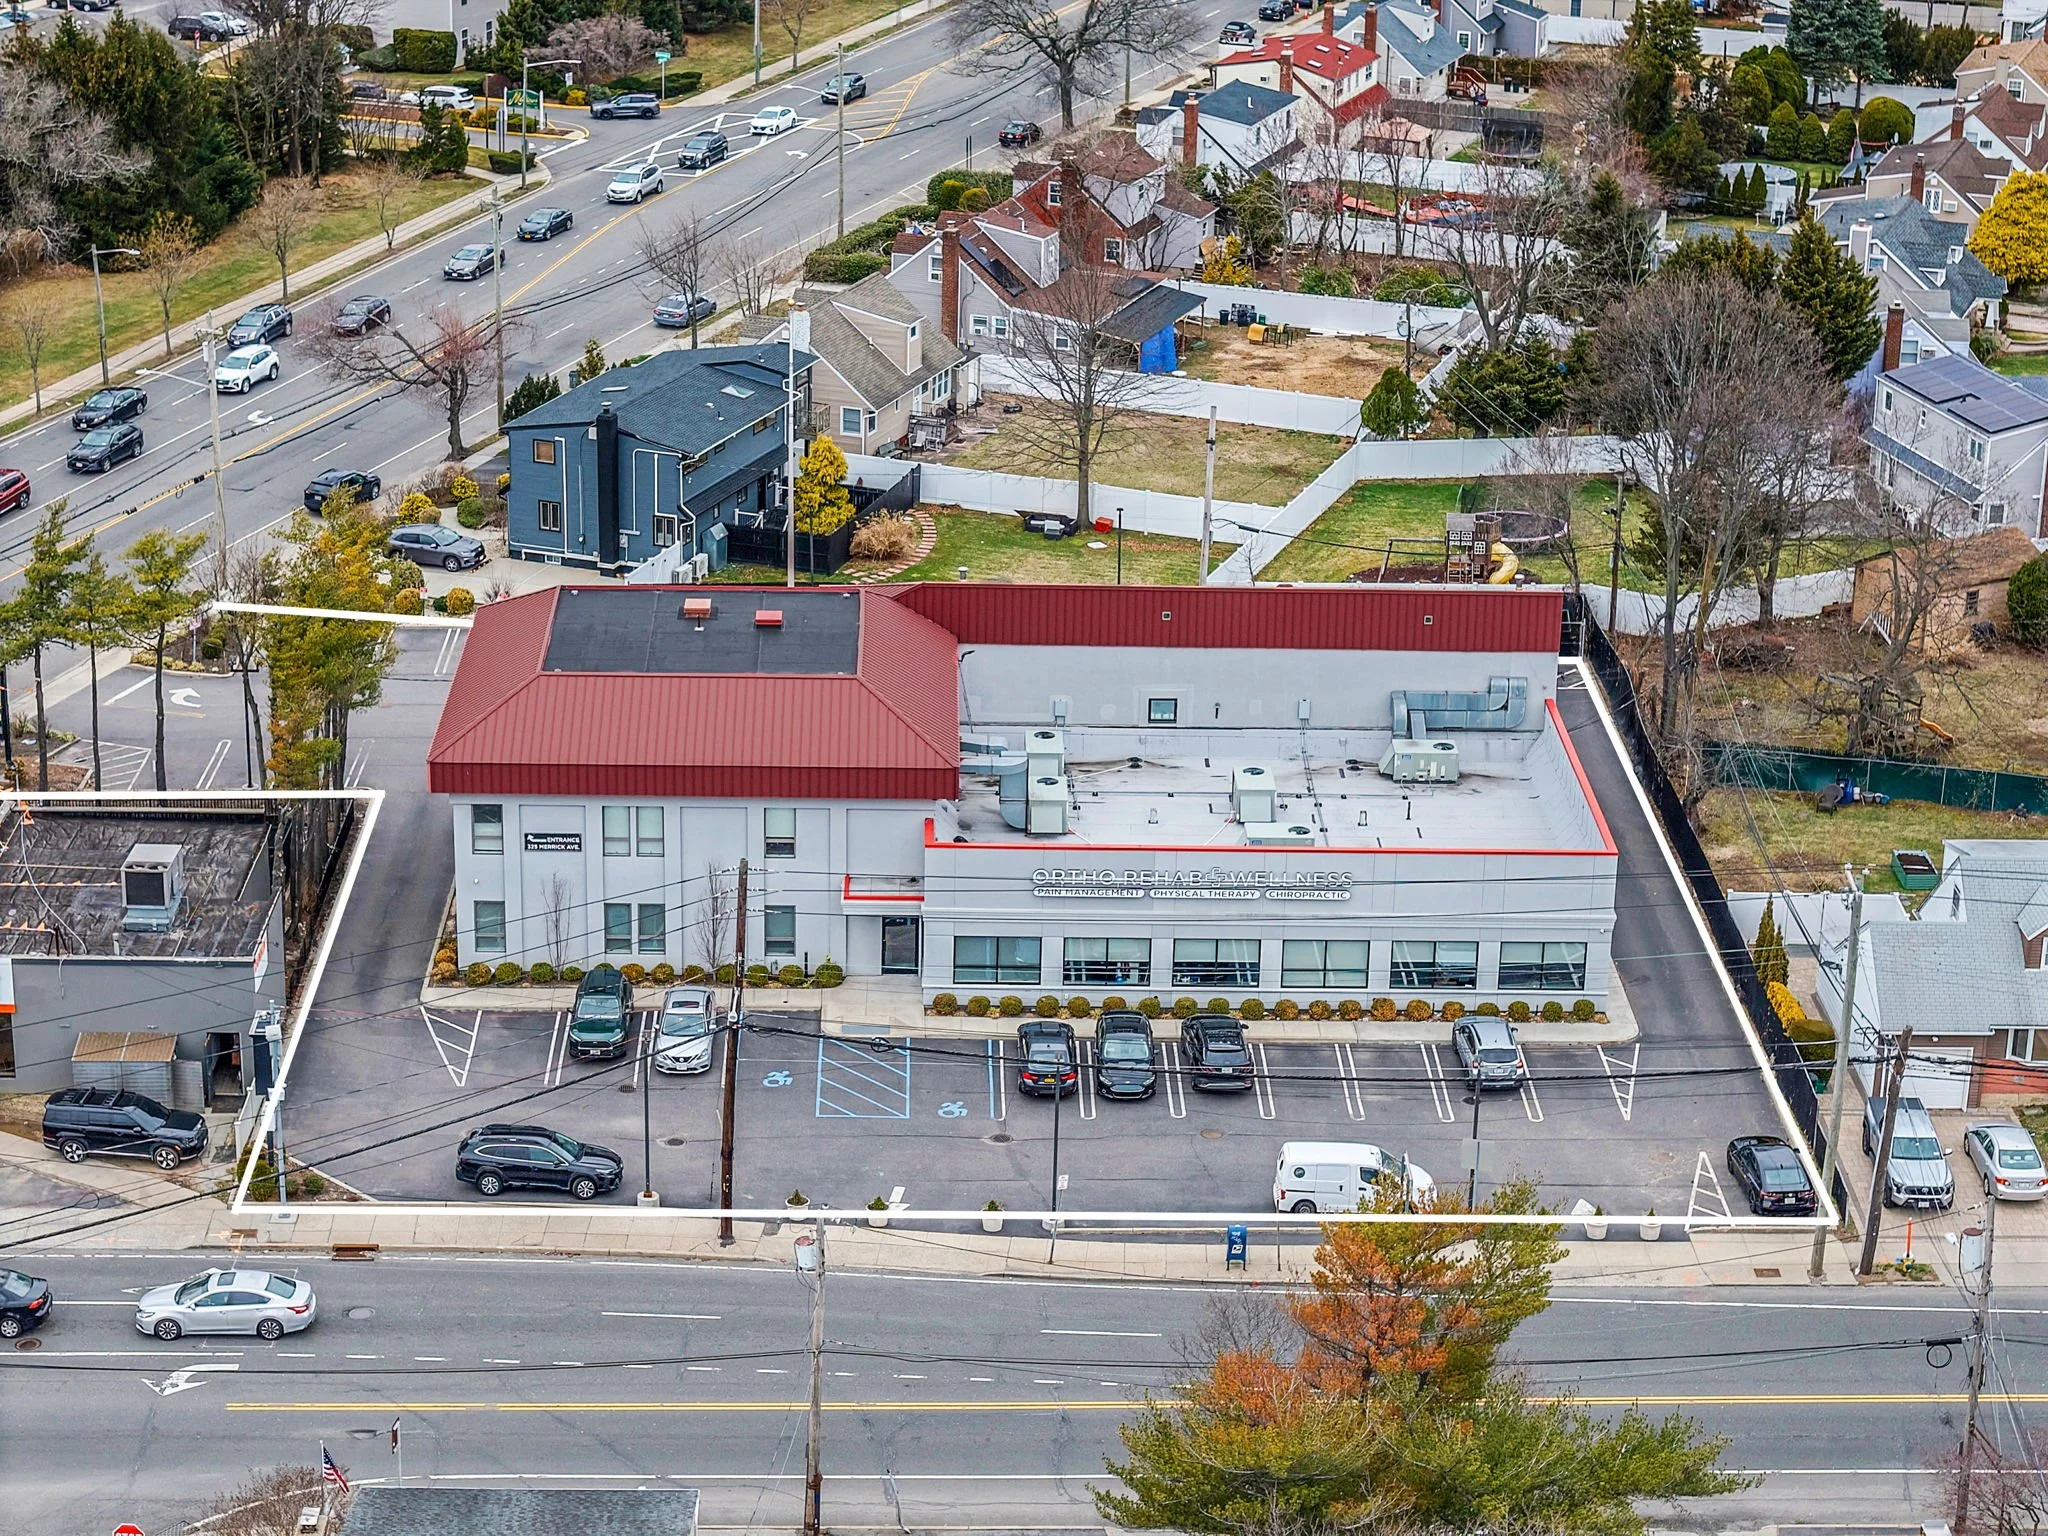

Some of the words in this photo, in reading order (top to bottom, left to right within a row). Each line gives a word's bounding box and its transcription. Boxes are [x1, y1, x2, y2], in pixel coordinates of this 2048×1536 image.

[1032, 869, 1116, 885] ORTHO
[1123, 870, 1203, 886] REHAB
[1229, 871, 1353, 888] WELLNESS
[1037, 888, 1062, 896] PAIN
[1064, 889, 1141, 897] MANAGEMENT
[1153, 890, 1203, 898] PHYSICAL
[1207, 890, 1257, 898] THERAPY
[1268, 890, 1348, 899] CHIROPRACTIC
